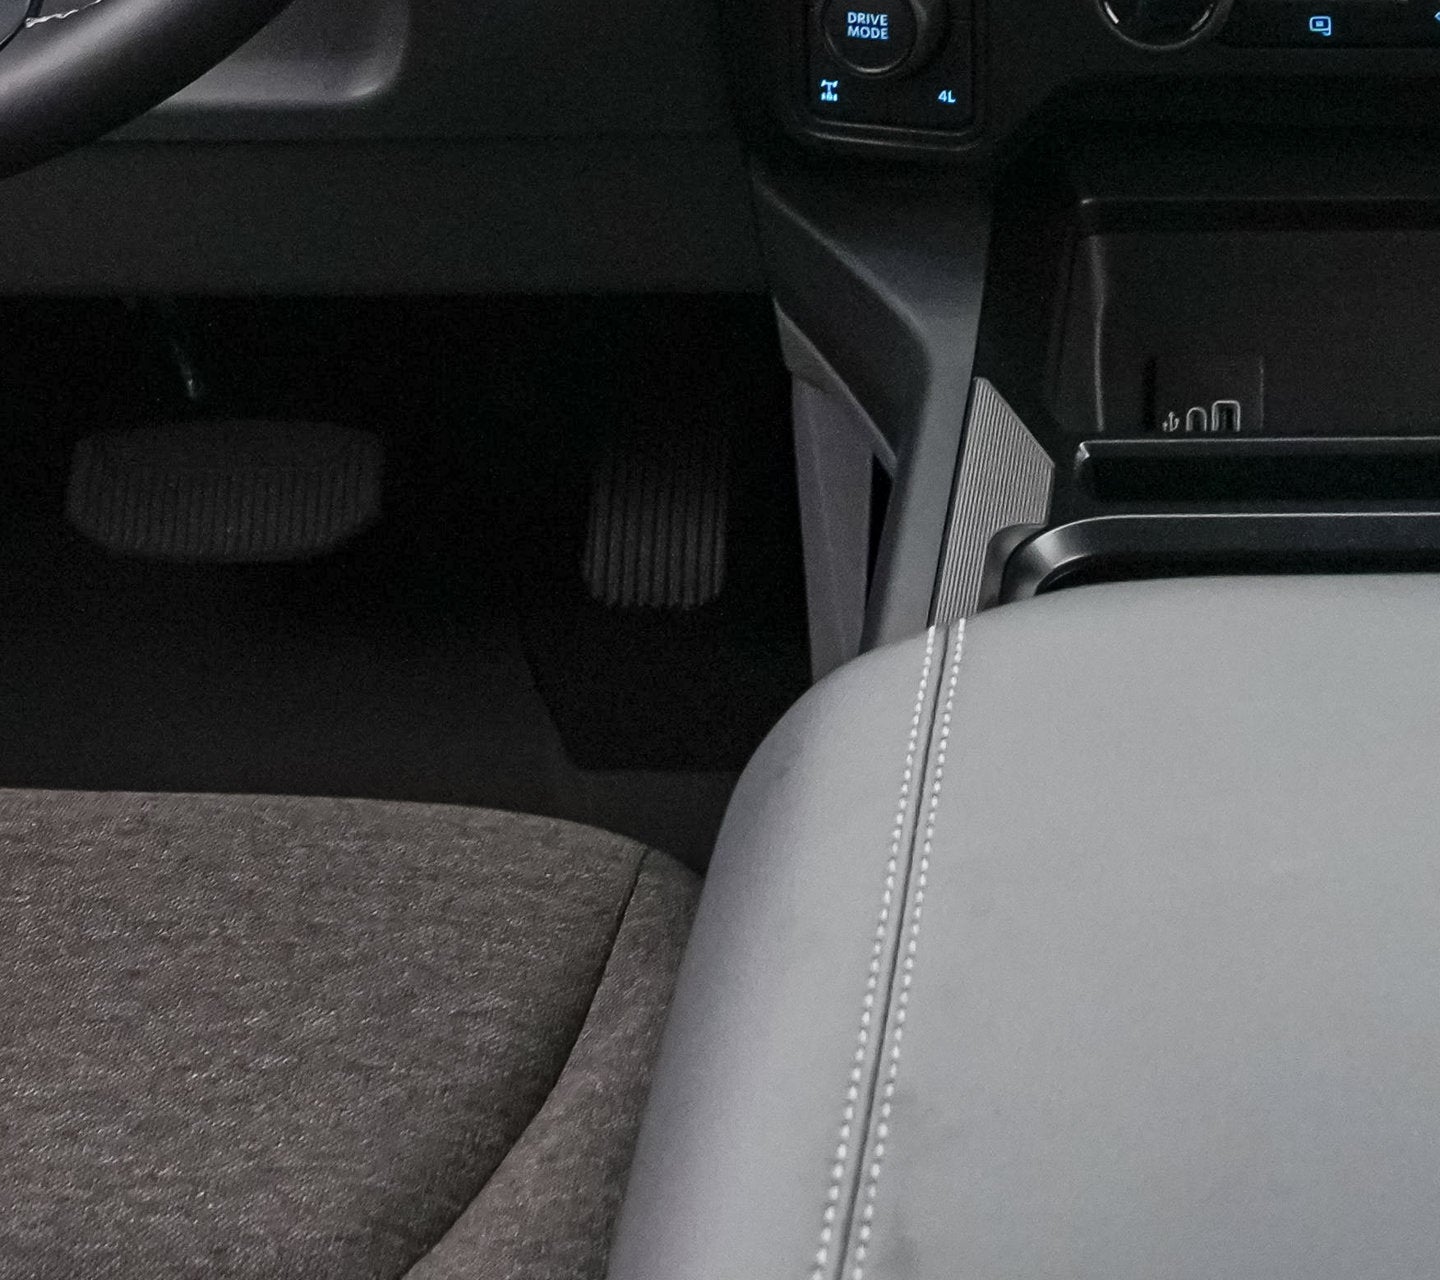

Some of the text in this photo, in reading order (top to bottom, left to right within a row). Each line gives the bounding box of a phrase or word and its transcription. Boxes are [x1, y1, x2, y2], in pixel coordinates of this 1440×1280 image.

[847, 12, 888, 27] DRIVE
[847, 25, 889, 40] MODE
[938, 90, 956, 103] 4L
